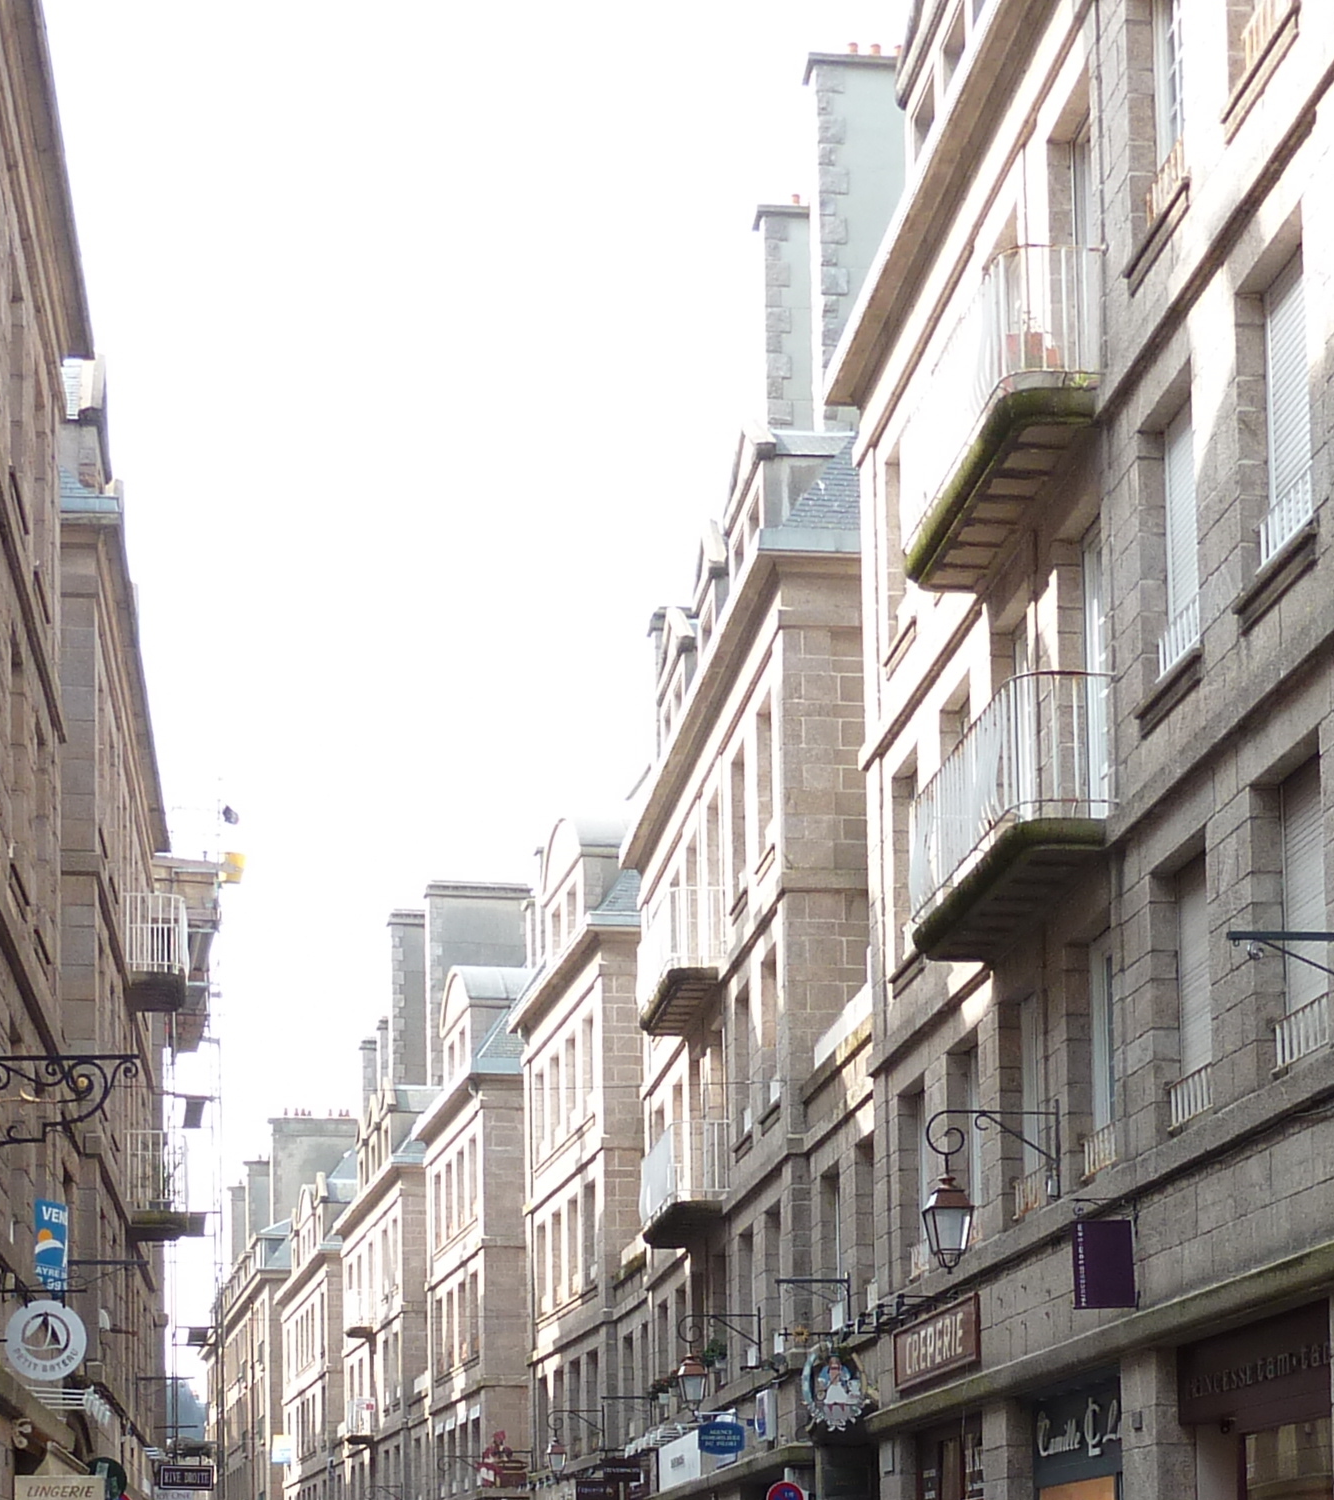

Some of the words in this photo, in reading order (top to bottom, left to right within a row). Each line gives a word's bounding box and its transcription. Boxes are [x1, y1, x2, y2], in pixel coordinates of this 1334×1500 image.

[164, 1471, 182, 1484] RIVE
[184, 1471, 210, 1484] DROITE
[27, 1486, 95, 1498] LINGERIE
